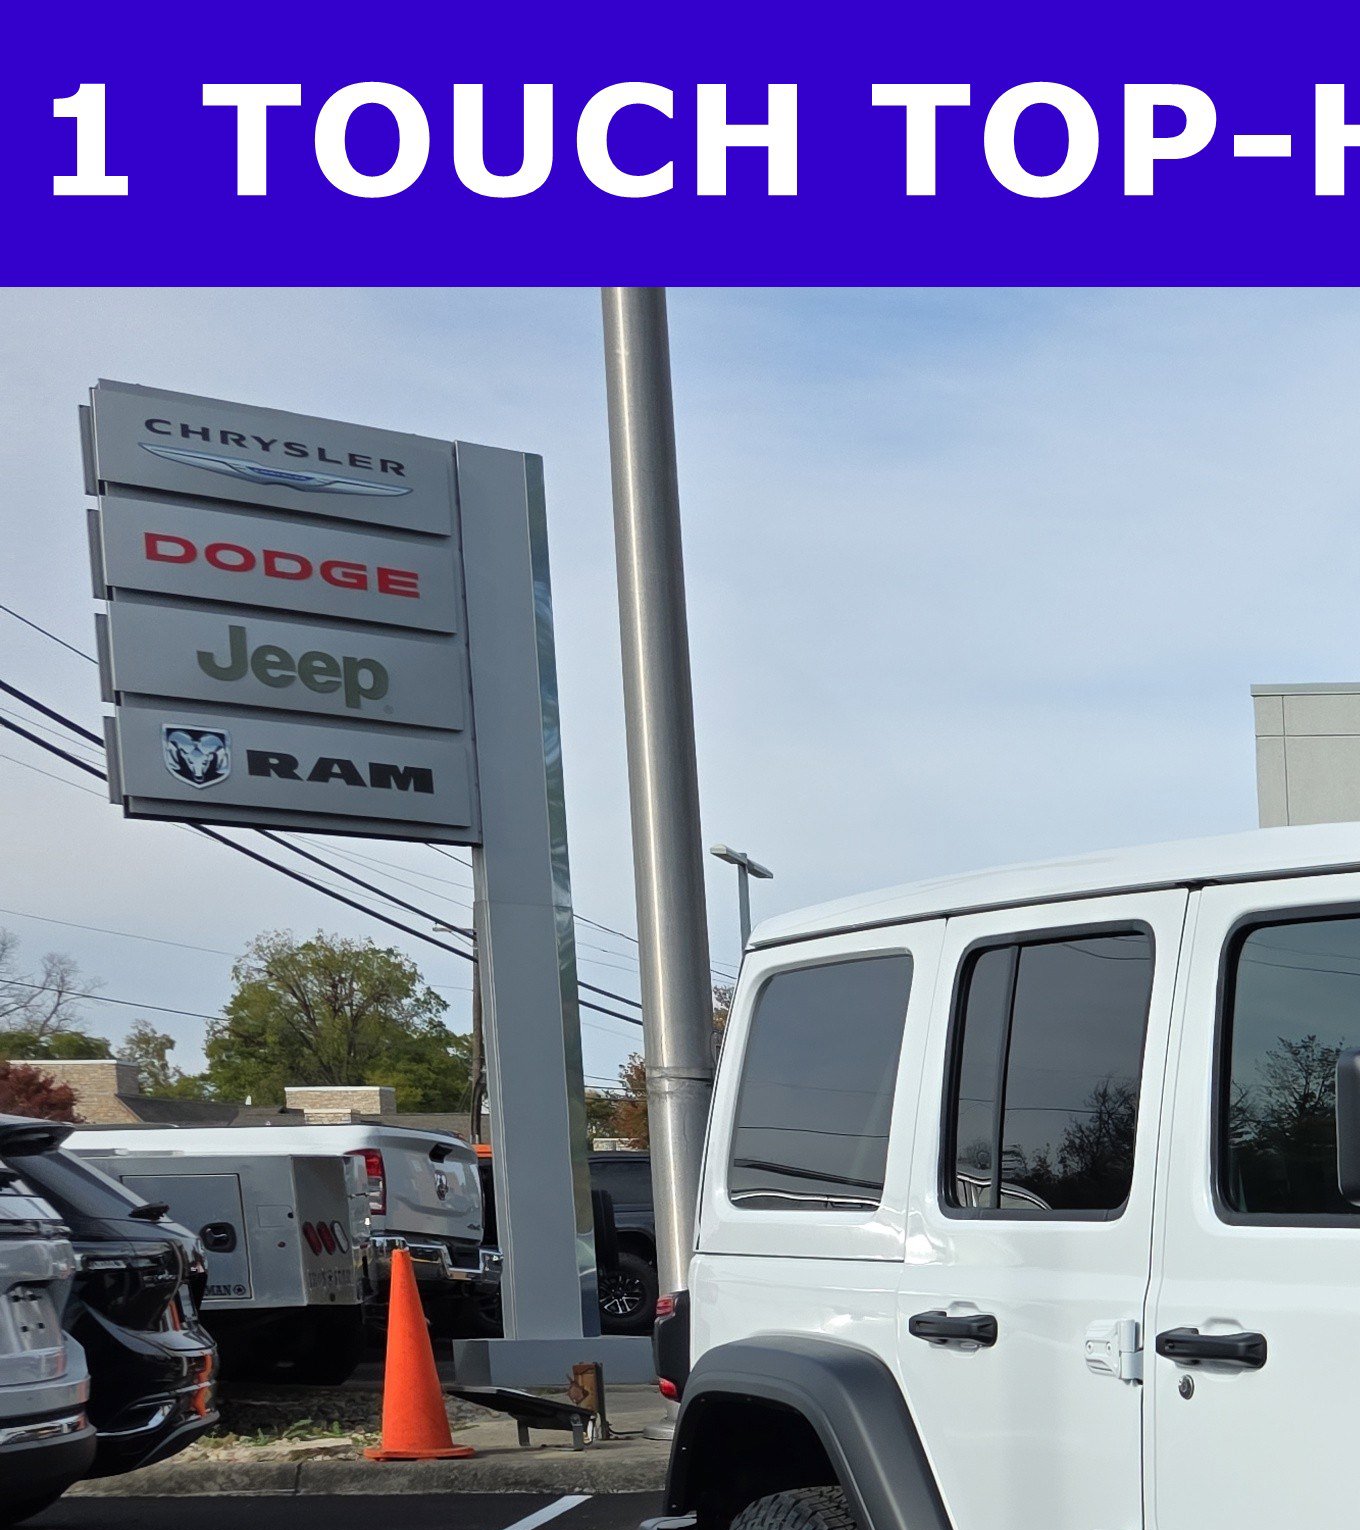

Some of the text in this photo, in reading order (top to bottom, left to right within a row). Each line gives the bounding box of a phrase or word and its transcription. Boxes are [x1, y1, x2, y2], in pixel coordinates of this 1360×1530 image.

[143, 418, 406, 478] CHRYSLER
[143, 532, 420, 598] DODGE
[196, 624, 390, 708] Jeep
[246, 749, 435, 795] RAM
